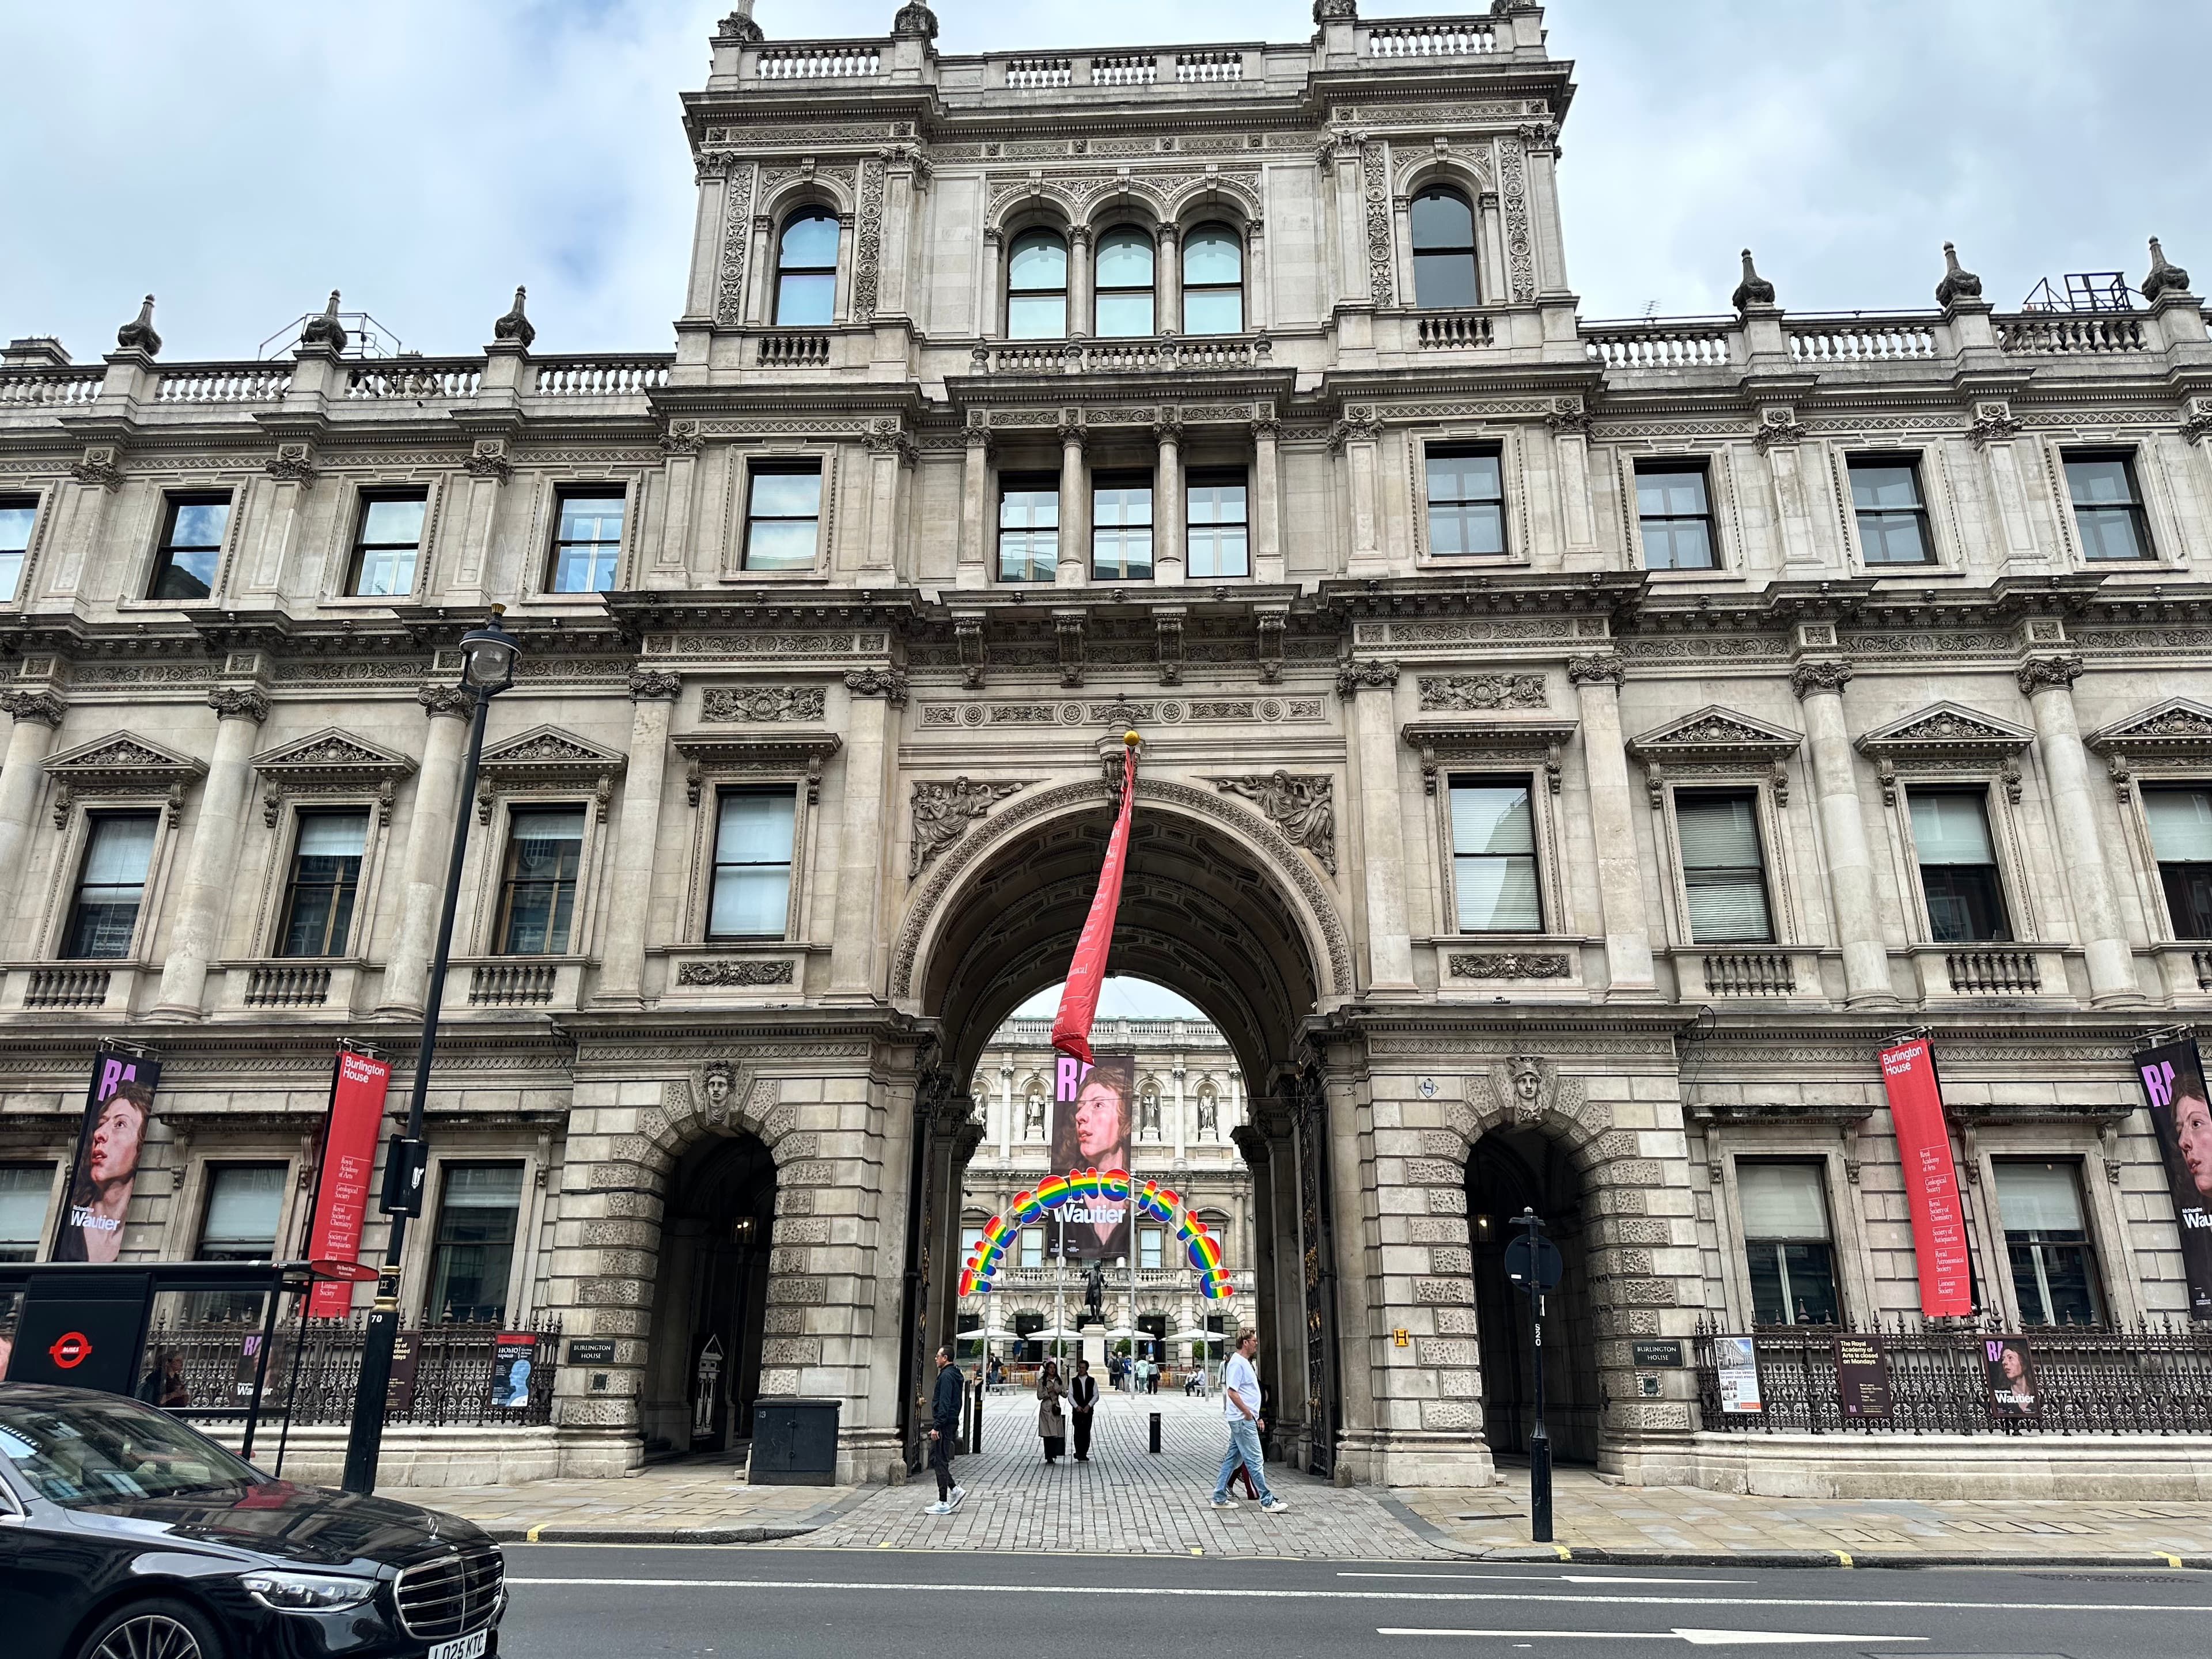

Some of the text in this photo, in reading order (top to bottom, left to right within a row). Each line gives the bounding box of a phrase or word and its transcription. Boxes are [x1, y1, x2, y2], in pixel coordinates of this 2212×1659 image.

[1883, 1046, 1923, 1065] Burlington
[345, 1055, 385, 1077] Burlington
[1885, 1062, 1912, 1076] House
[343, 1067, 369, 1083] House
[2141, 1060, 2175, 1107] RA
[1919, 1150, 1930, 1158] Royal
[341, 1157, 353, 1166] Royal
[1922, 1157, 1940, 1165] Academy
[340, 1164, 359, 1175] Academy
[1925, 1176, 1947, 1186] Geological
[336, 1184, 358, 1194] Geological
[335, 1191, 350, 1201] Society
[1929, 1199, 1941, 1207] Royal
[332, 1204, 346, 1213] Royal
[1054, 1203, 1126, 1224] Wautier
[1930, 1207, 1944, 1215] Society
[71, 1210, 120, 1230] Wautier
[331, 1211, 346, 1222] Society
[1930, 1214, 1953, 1222] Chemistry
[330, 1218, 353, 1230] Chemistry
[328, 1232, 343, 1242] Society
[1012, 1166, 1131, 1225] SONG
[1138, 1179, 1180, 1222] IS
[1176, 1210, 1234, 1300] YOU
[1932, 1229, 1948, 1237] Society
[1934, 1236, 1958, 1244] Antiquaries
[1936, 1249, 1948, 1257] Royal
[1936, 1256, 1964, 1265] Astronomical
[1936, 1265, 1952, 1273] Society
[320, 1289, 335, 1297] Society
[1938, 1287, 1954, 1296] Society
[1396, 1330, 1407, 1344] H
[1995, 1393, 2035, 1403] Wautier
[466, 1633, 483, 1657] KTC
